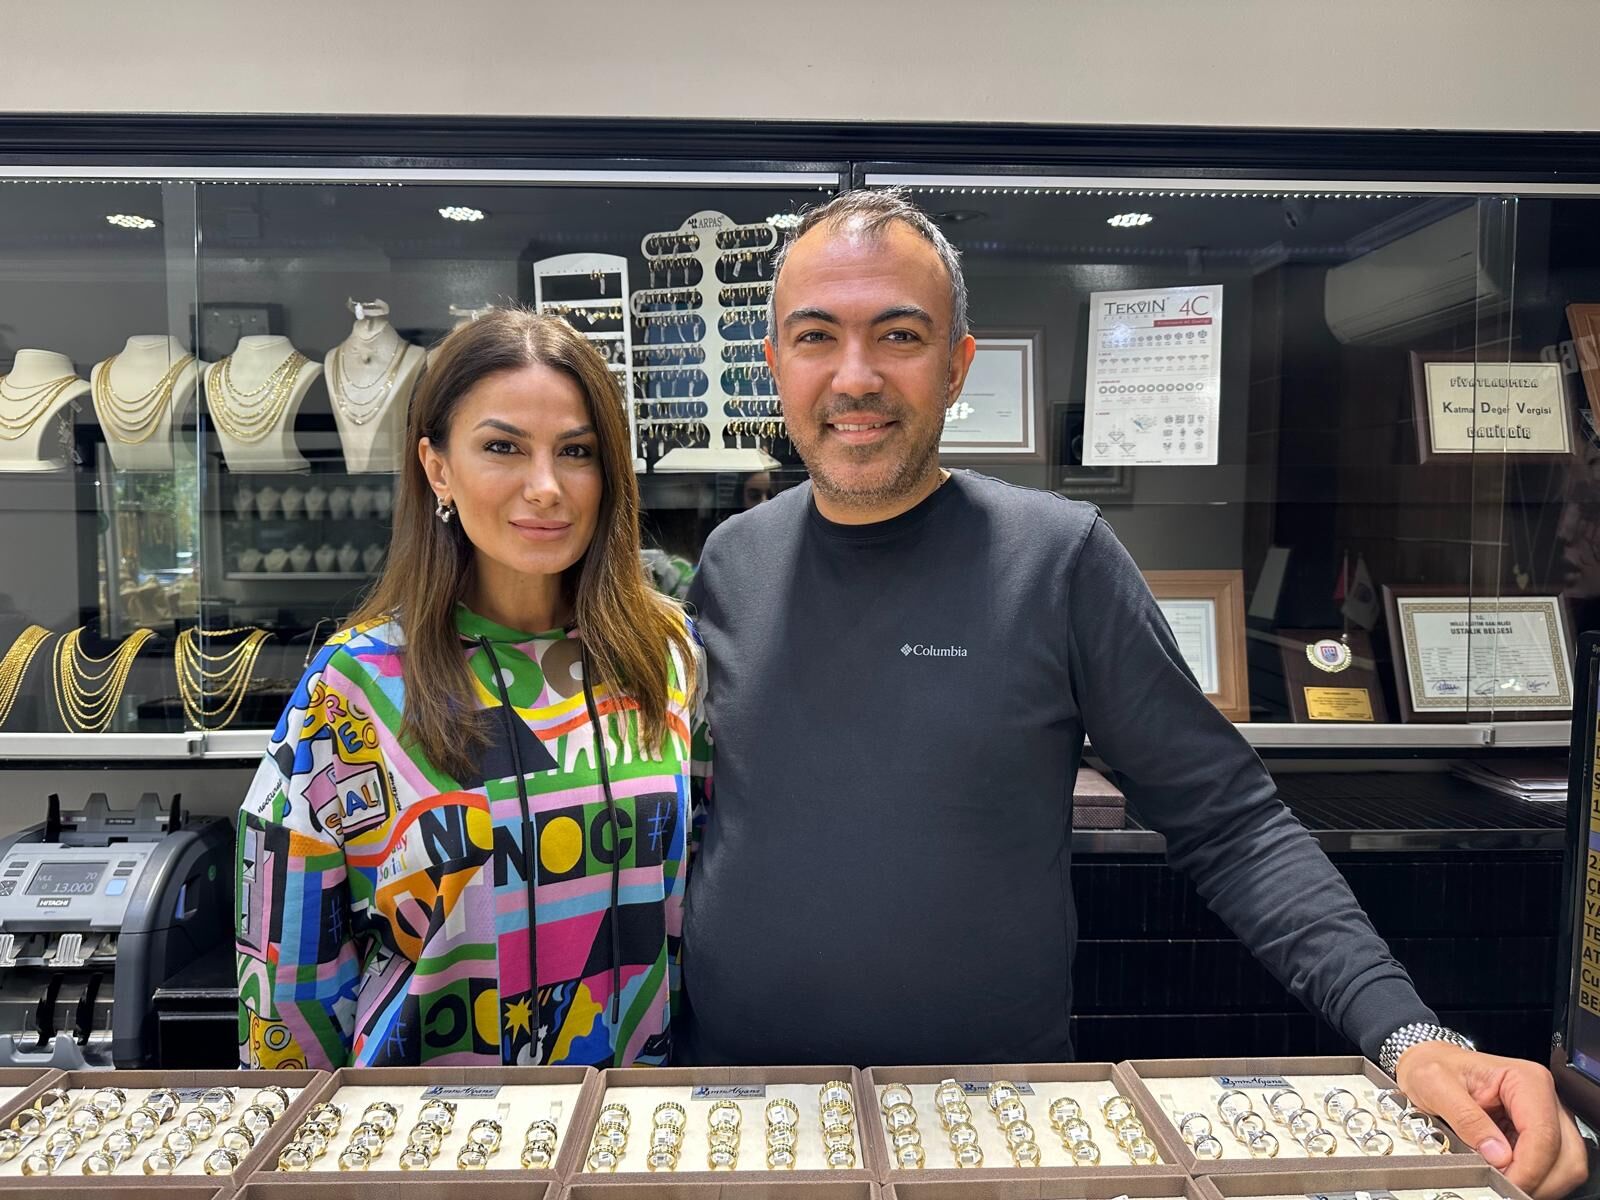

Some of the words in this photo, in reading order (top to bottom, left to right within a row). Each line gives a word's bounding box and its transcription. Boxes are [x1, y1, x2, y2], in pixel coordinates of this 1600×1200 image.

[698, 217, 722, 229] ARPAS
[1179, 295, 1209, 316] 4C
[1442, 402, 1475, 414] Katma
[1516, 402, 1552, 415] Vergisi
[1467, 424, 1531, 439] DAHİLDİR
[913, 644, 968, 657] Columbia
